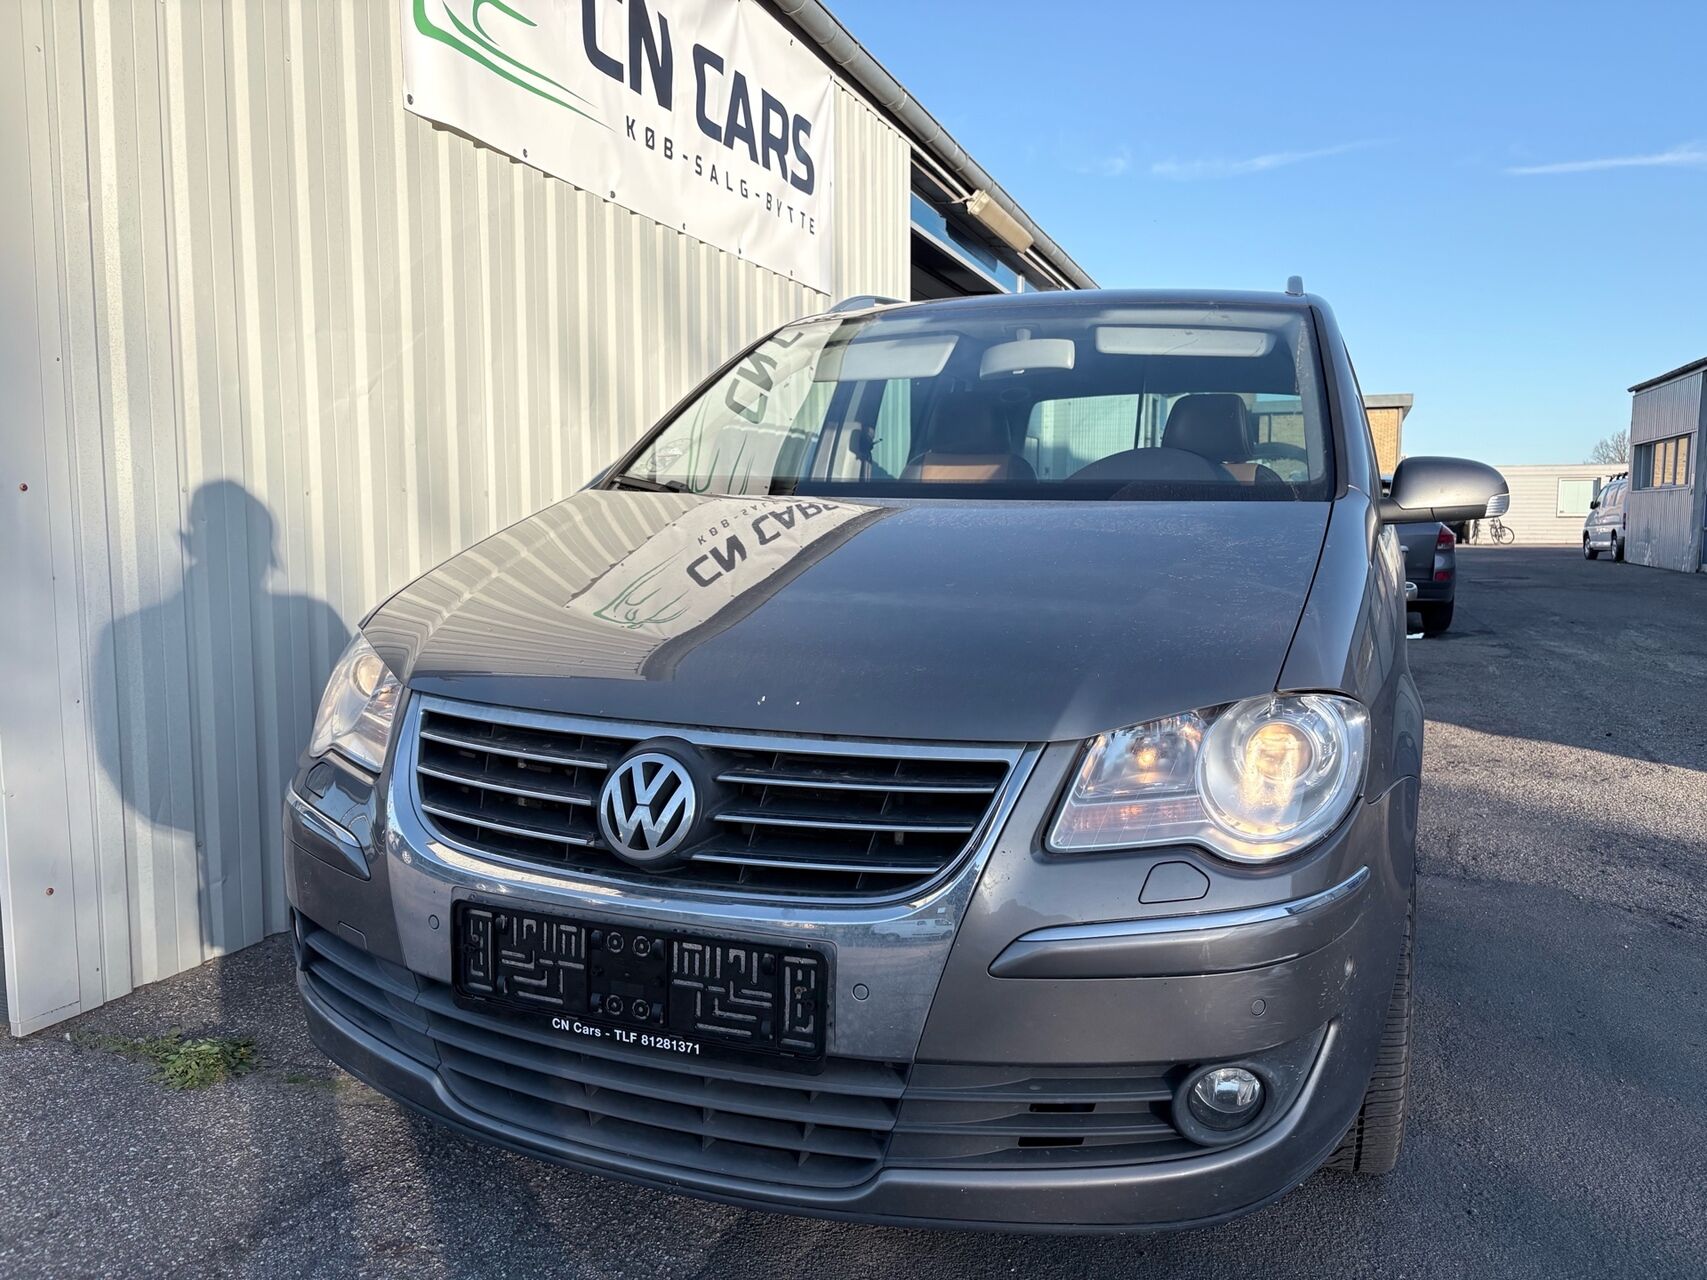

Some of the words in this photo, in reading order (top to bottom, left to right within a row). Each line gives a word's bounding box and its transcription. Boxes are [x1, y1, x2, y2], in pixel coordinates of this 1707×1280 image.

[581, 0, 673, 112] CN
[692, 43, 815, 196] CARS
[603, 756, 692, 856] VW
[552, 1017, 570, 1031] CN
[573, 1022, 601, 1037] Cars
[614, 1029, 638, 1044] TLF
[641, 1034, 700, 1055] 81281371
